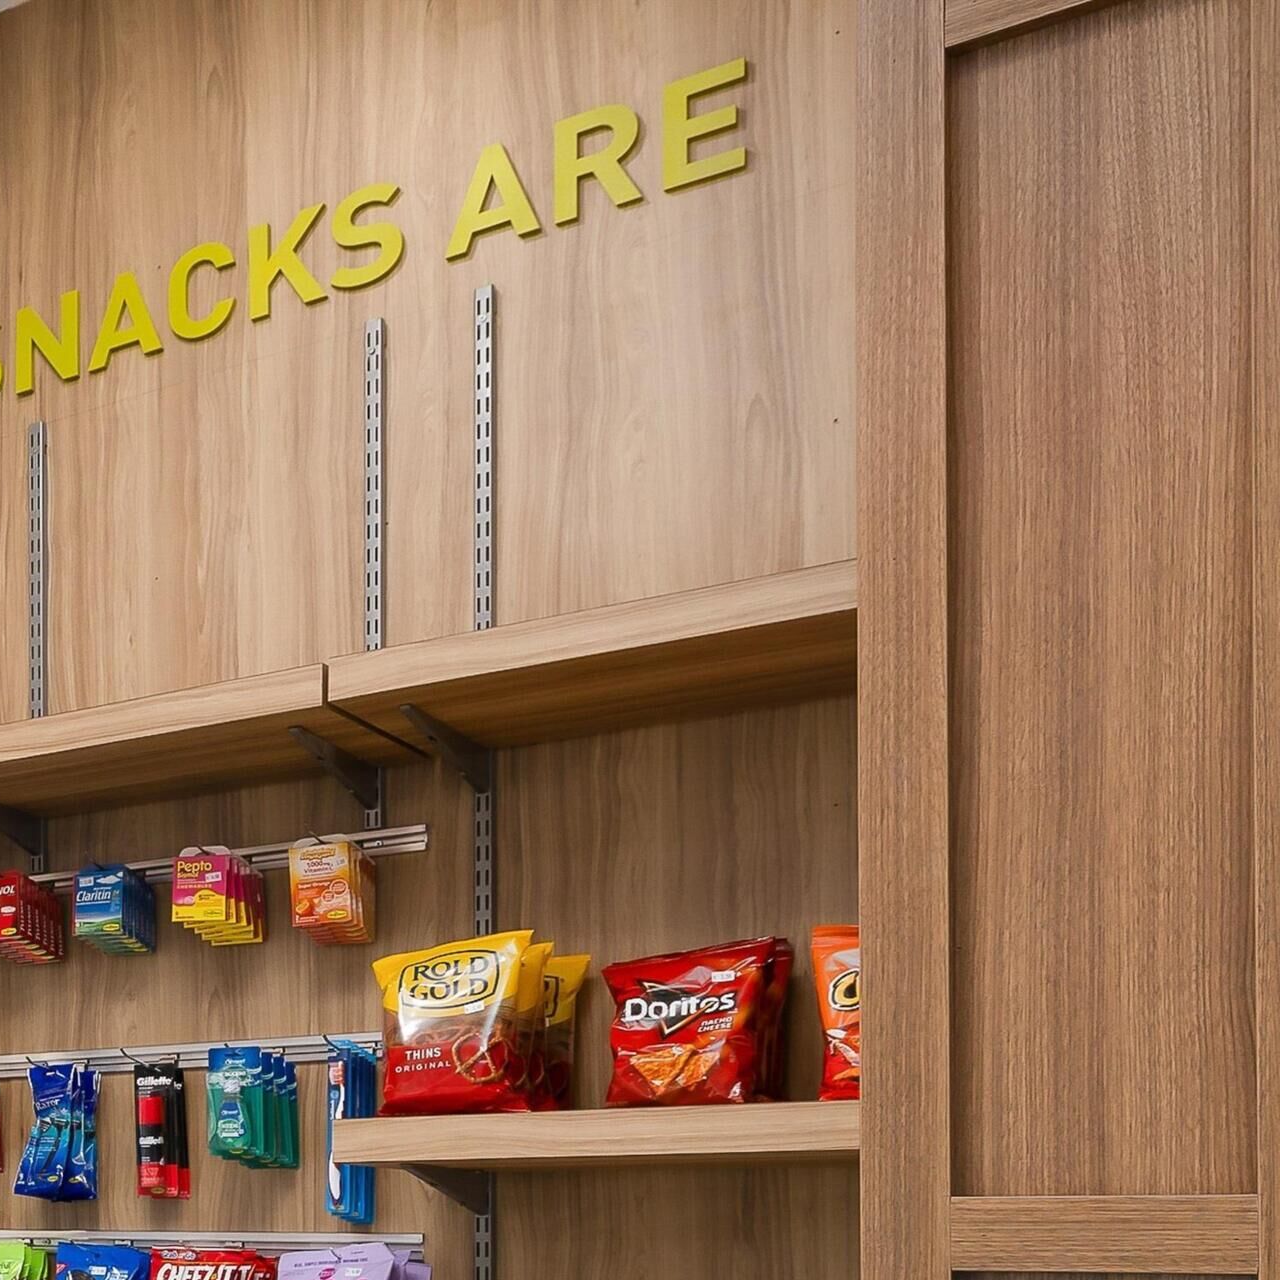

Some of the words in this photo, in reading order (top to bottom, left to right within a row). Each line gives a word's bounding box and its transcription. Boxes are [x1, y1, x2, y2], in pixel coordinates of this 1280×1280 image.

[446, 56, 749, 261] ARE
[177, 861, 212, 875] Pepto
[76, 890, 111, 902] Claritin
[412, 955, 490, 984] ROLD
[409, 978, 490, 1002] GOLD
[623, 993, 736, 1023] Doritos
[697, 1021, 733, 1033] CHEESE
[701, 1016, 733, 1028] NACHO
[405, 1047, 441, 1061] THINS
[395, 1060, 451, 1073] ORIGINAL
[137, 1077, 171, 1087] Gillette
